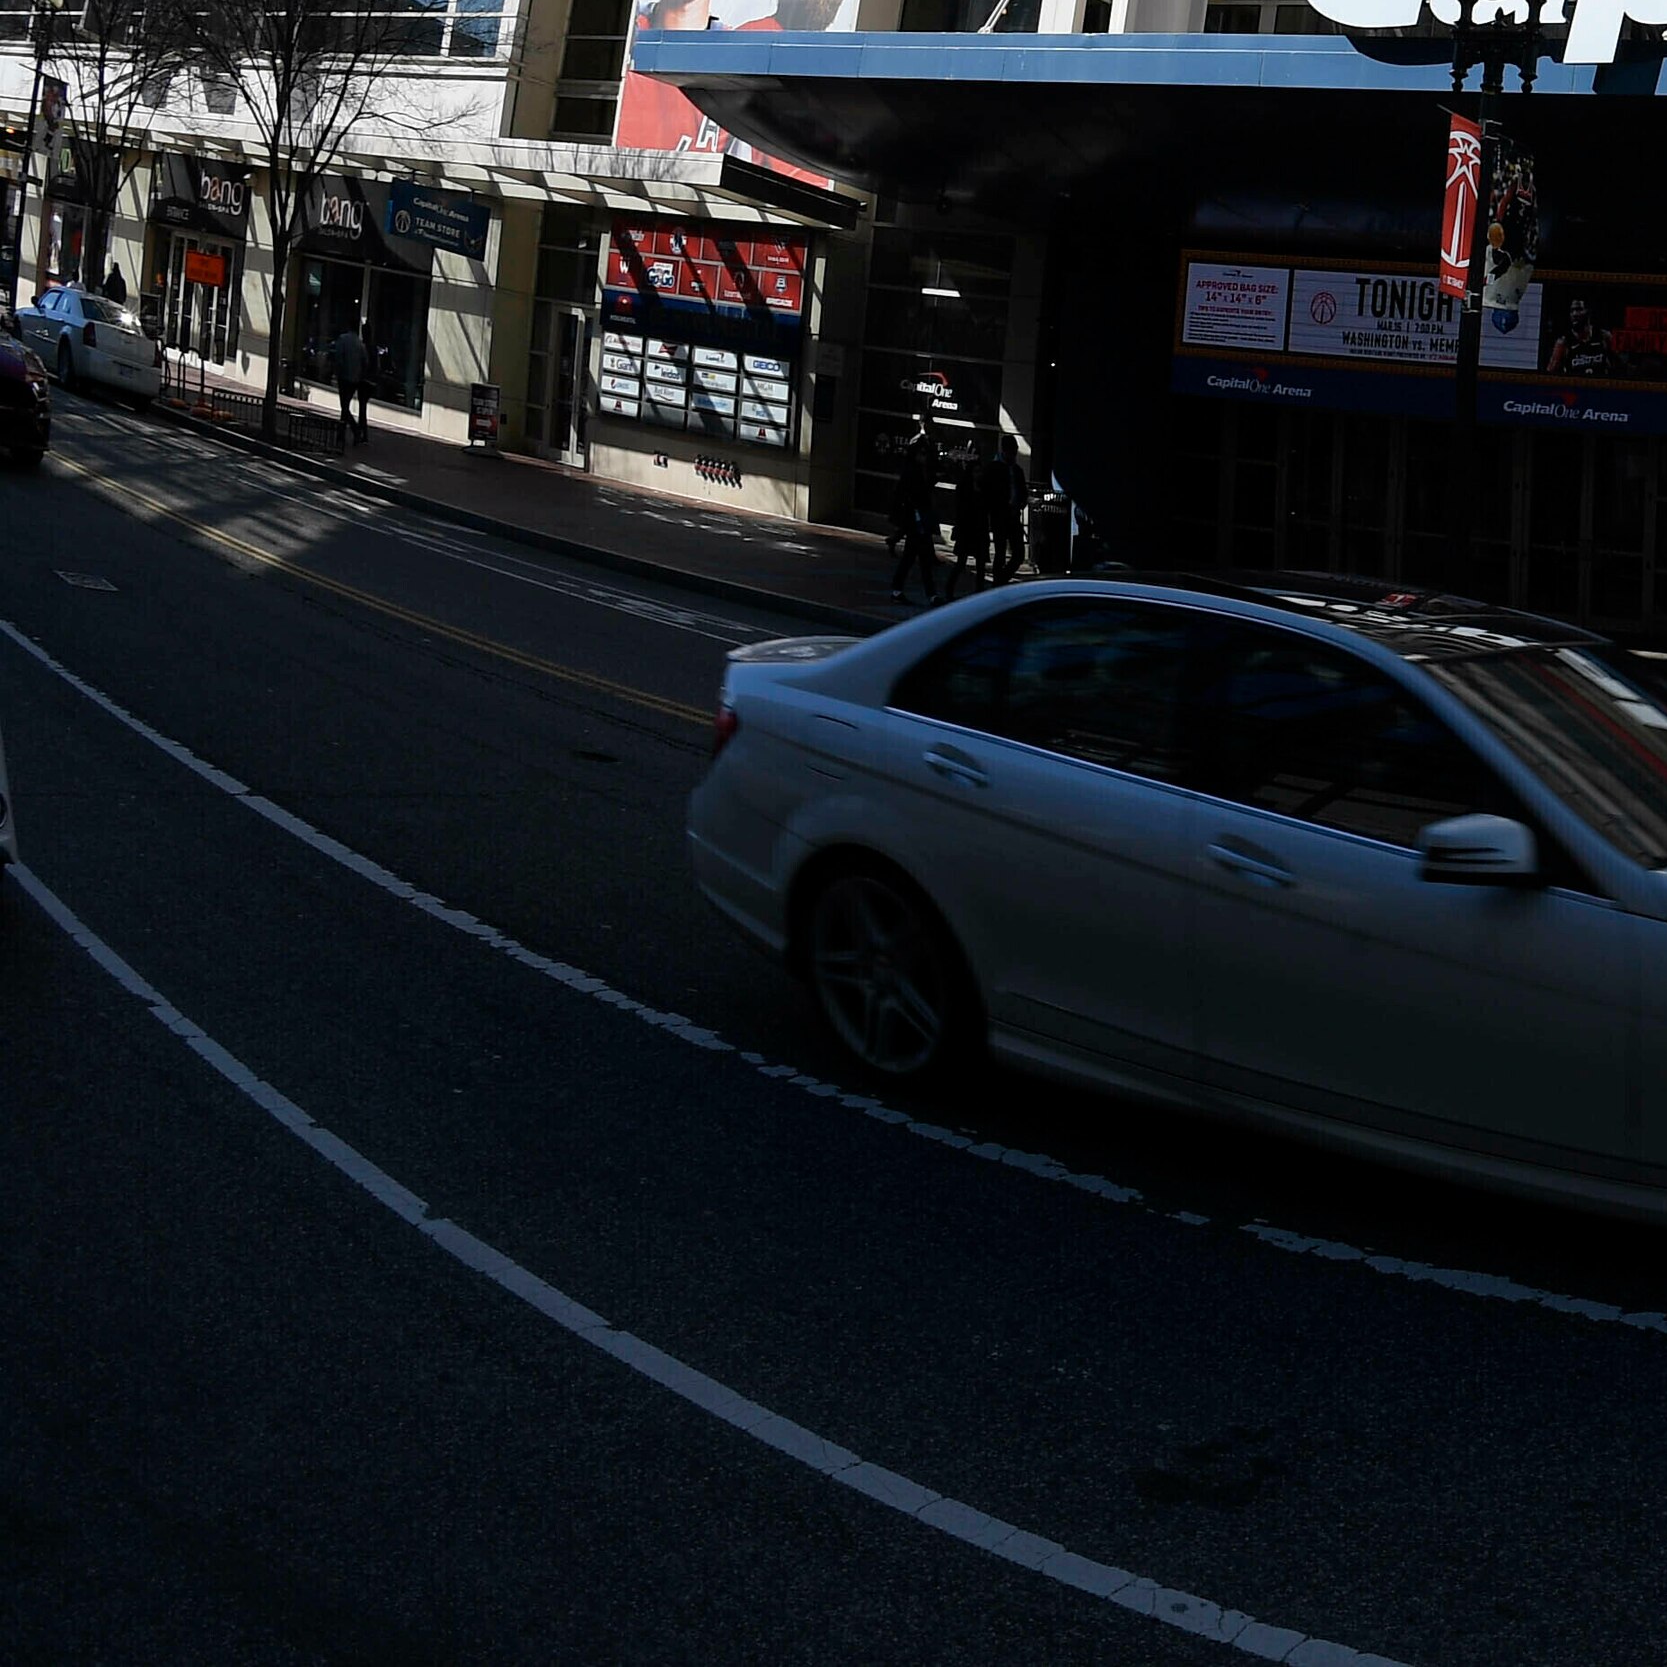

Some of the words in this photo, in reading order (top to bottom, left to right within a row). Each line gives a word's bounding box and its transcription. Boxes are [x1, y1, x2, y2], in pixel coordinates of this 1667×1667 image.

[201, 169, 244, 216] bang
[320, 193, 366, 241] bang
[416, 217, 436, 231] TEAM
[437, 224, 461, 239] STORE
[1196, 280, 1239, 292] APPROVED
[1239, 282, 1256, 293] BAG
[1256, 284, 1279, 295] SIZE:
[1356, 278, 1452, 322] TONIGH
[1342, 331, 1409, 351] WASHINGTON
[752, 360, 781, 372] GEICO
[1273, 384, 1313, 398] Arena
[1582, 409, 1630, 423] Arena
